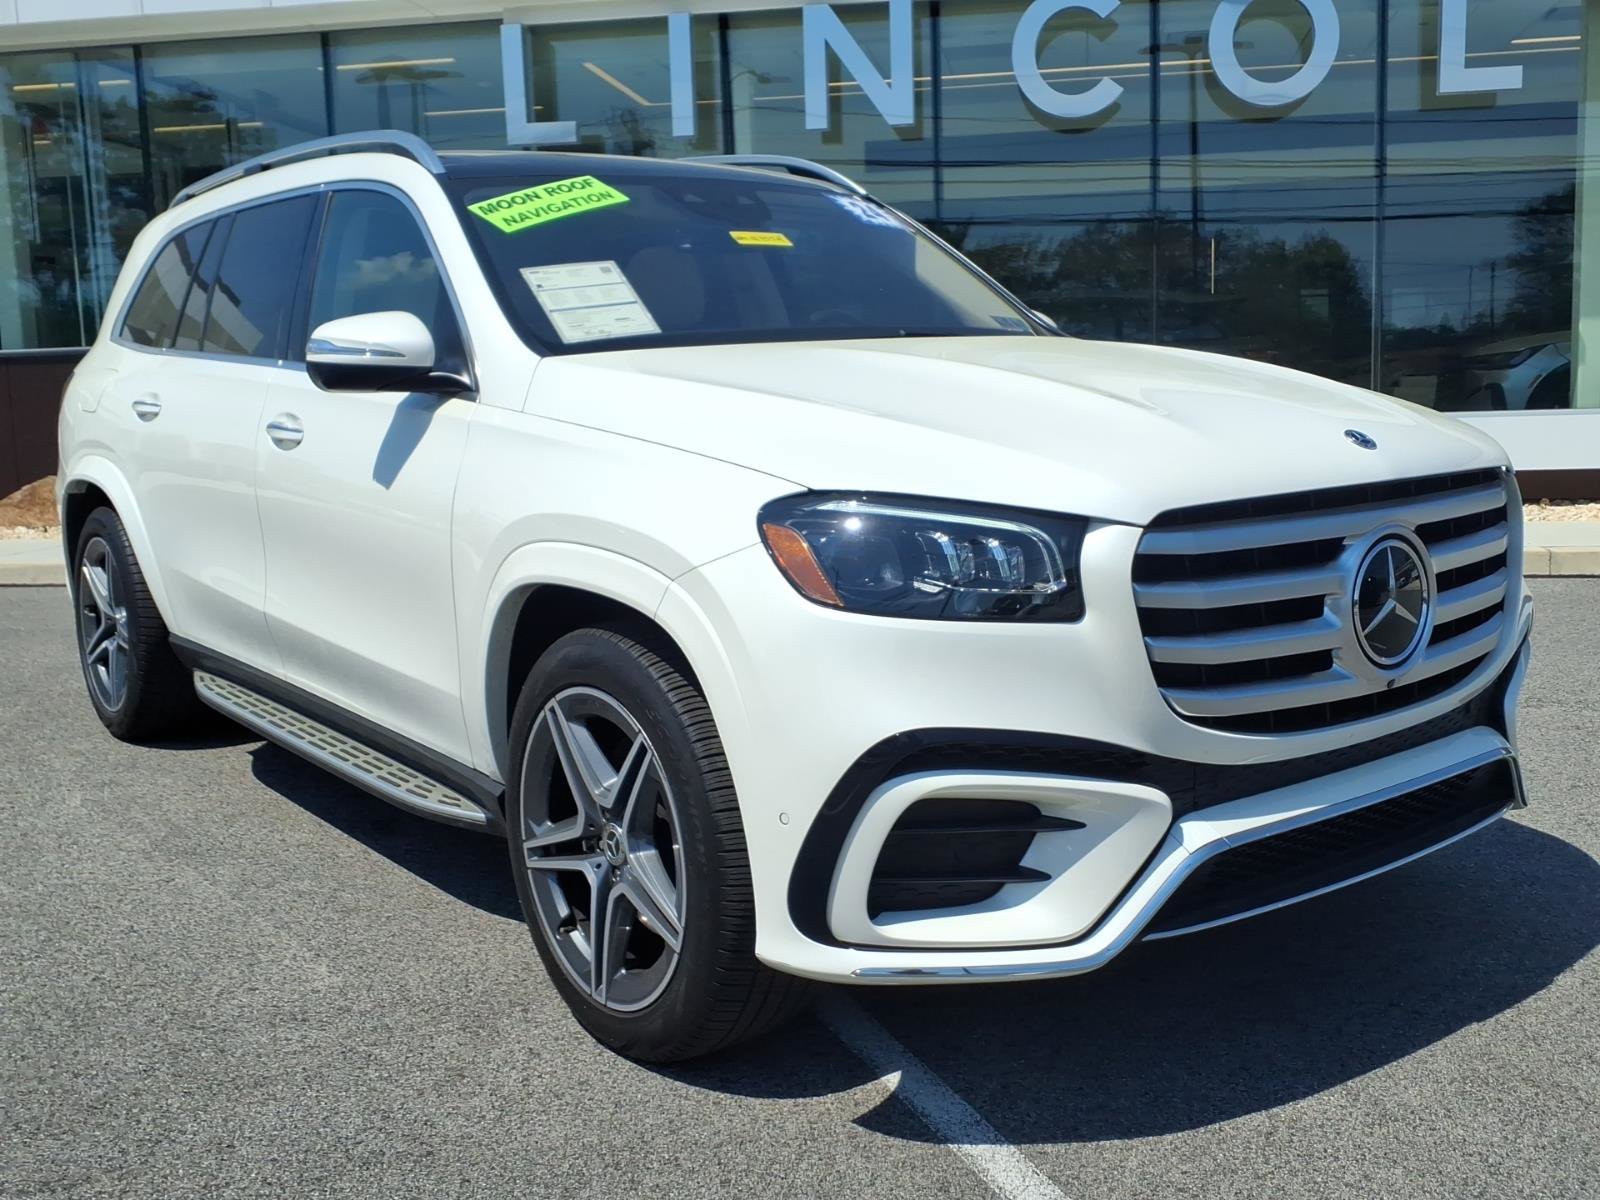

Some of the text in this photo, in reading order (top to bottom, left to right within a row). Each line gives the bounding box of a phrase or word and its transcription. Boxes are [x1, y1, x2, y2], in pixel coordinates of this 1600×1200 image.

[478, 178, 595, 216] MOON ROOF
[502, 190, 615, 227] NAVIGATION
